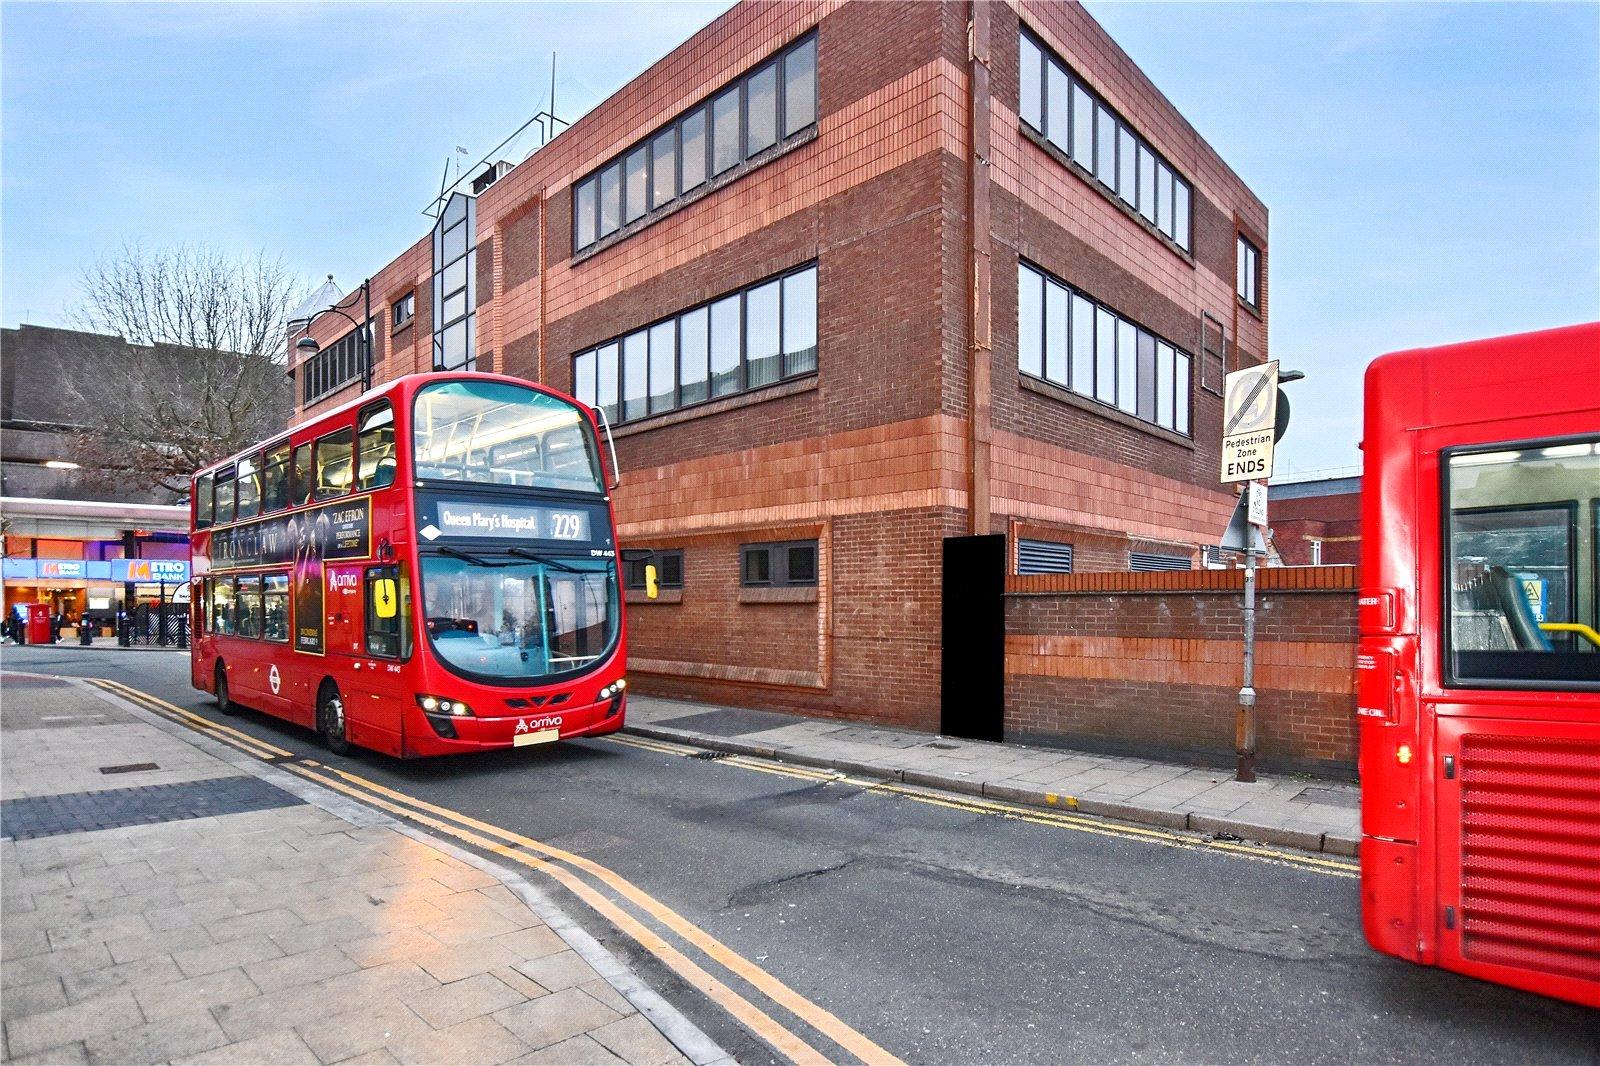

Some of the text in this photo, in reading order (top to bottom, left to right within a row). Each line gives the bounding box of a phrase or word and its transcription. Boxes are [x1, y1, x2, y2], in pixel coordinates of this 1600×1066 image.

[1225, 434, 1271, 448] Pedestrian
[1237, 448, 1257, 458] Zone
[1227, 458, 1265, 475] ENDS
[442, 510, 537, 533] Queen Mary's Hospital
[552, 513, 580, 539] 229
[127, 559, 185, 580] METRO
[152, 572, 185, 581] BANK
[529, 715, 563, 729] arriva
